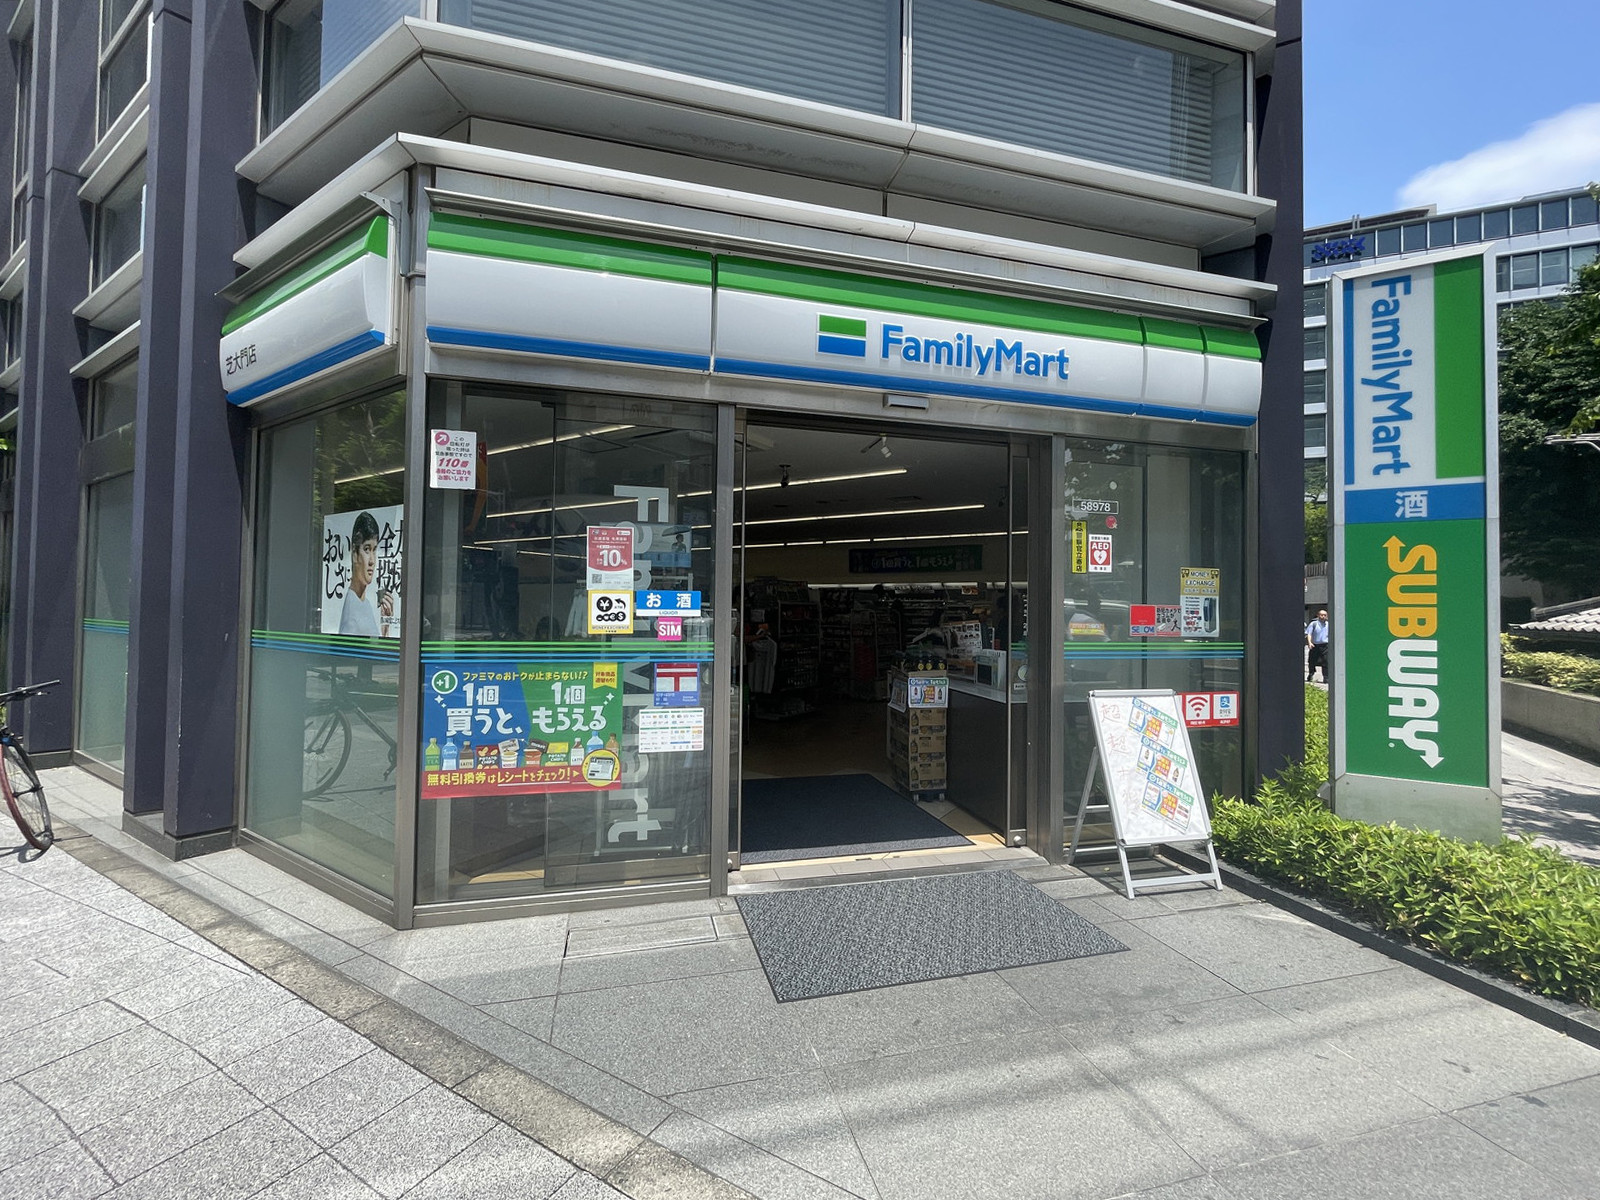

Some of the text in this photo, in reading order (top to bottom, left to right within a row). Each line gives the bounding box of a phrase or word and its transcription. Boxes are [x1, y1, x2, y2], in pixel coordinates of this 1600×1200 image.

[225, 344, 257, 376] 芝大門店
[881, 323, 1070, 380] FamilyMart
[1361, 274, 1413, 477] FamilyMart
[438, 457, 470, 468] 110番
[1080, 501, 1111, 512] 58978
[1395, 490, 1429, 518] 酒
[1091, 542, 1110, 550] AED
[646, 592, 692, 608] お酒
[658, 624, 681, 636] SIM
[1382, 535, 1445, 769] SUBWAY
[462, 682, 500, 707] 1個
[551, 681, 586, 705] 1個
[532, 705, 607, 734] もらえる
